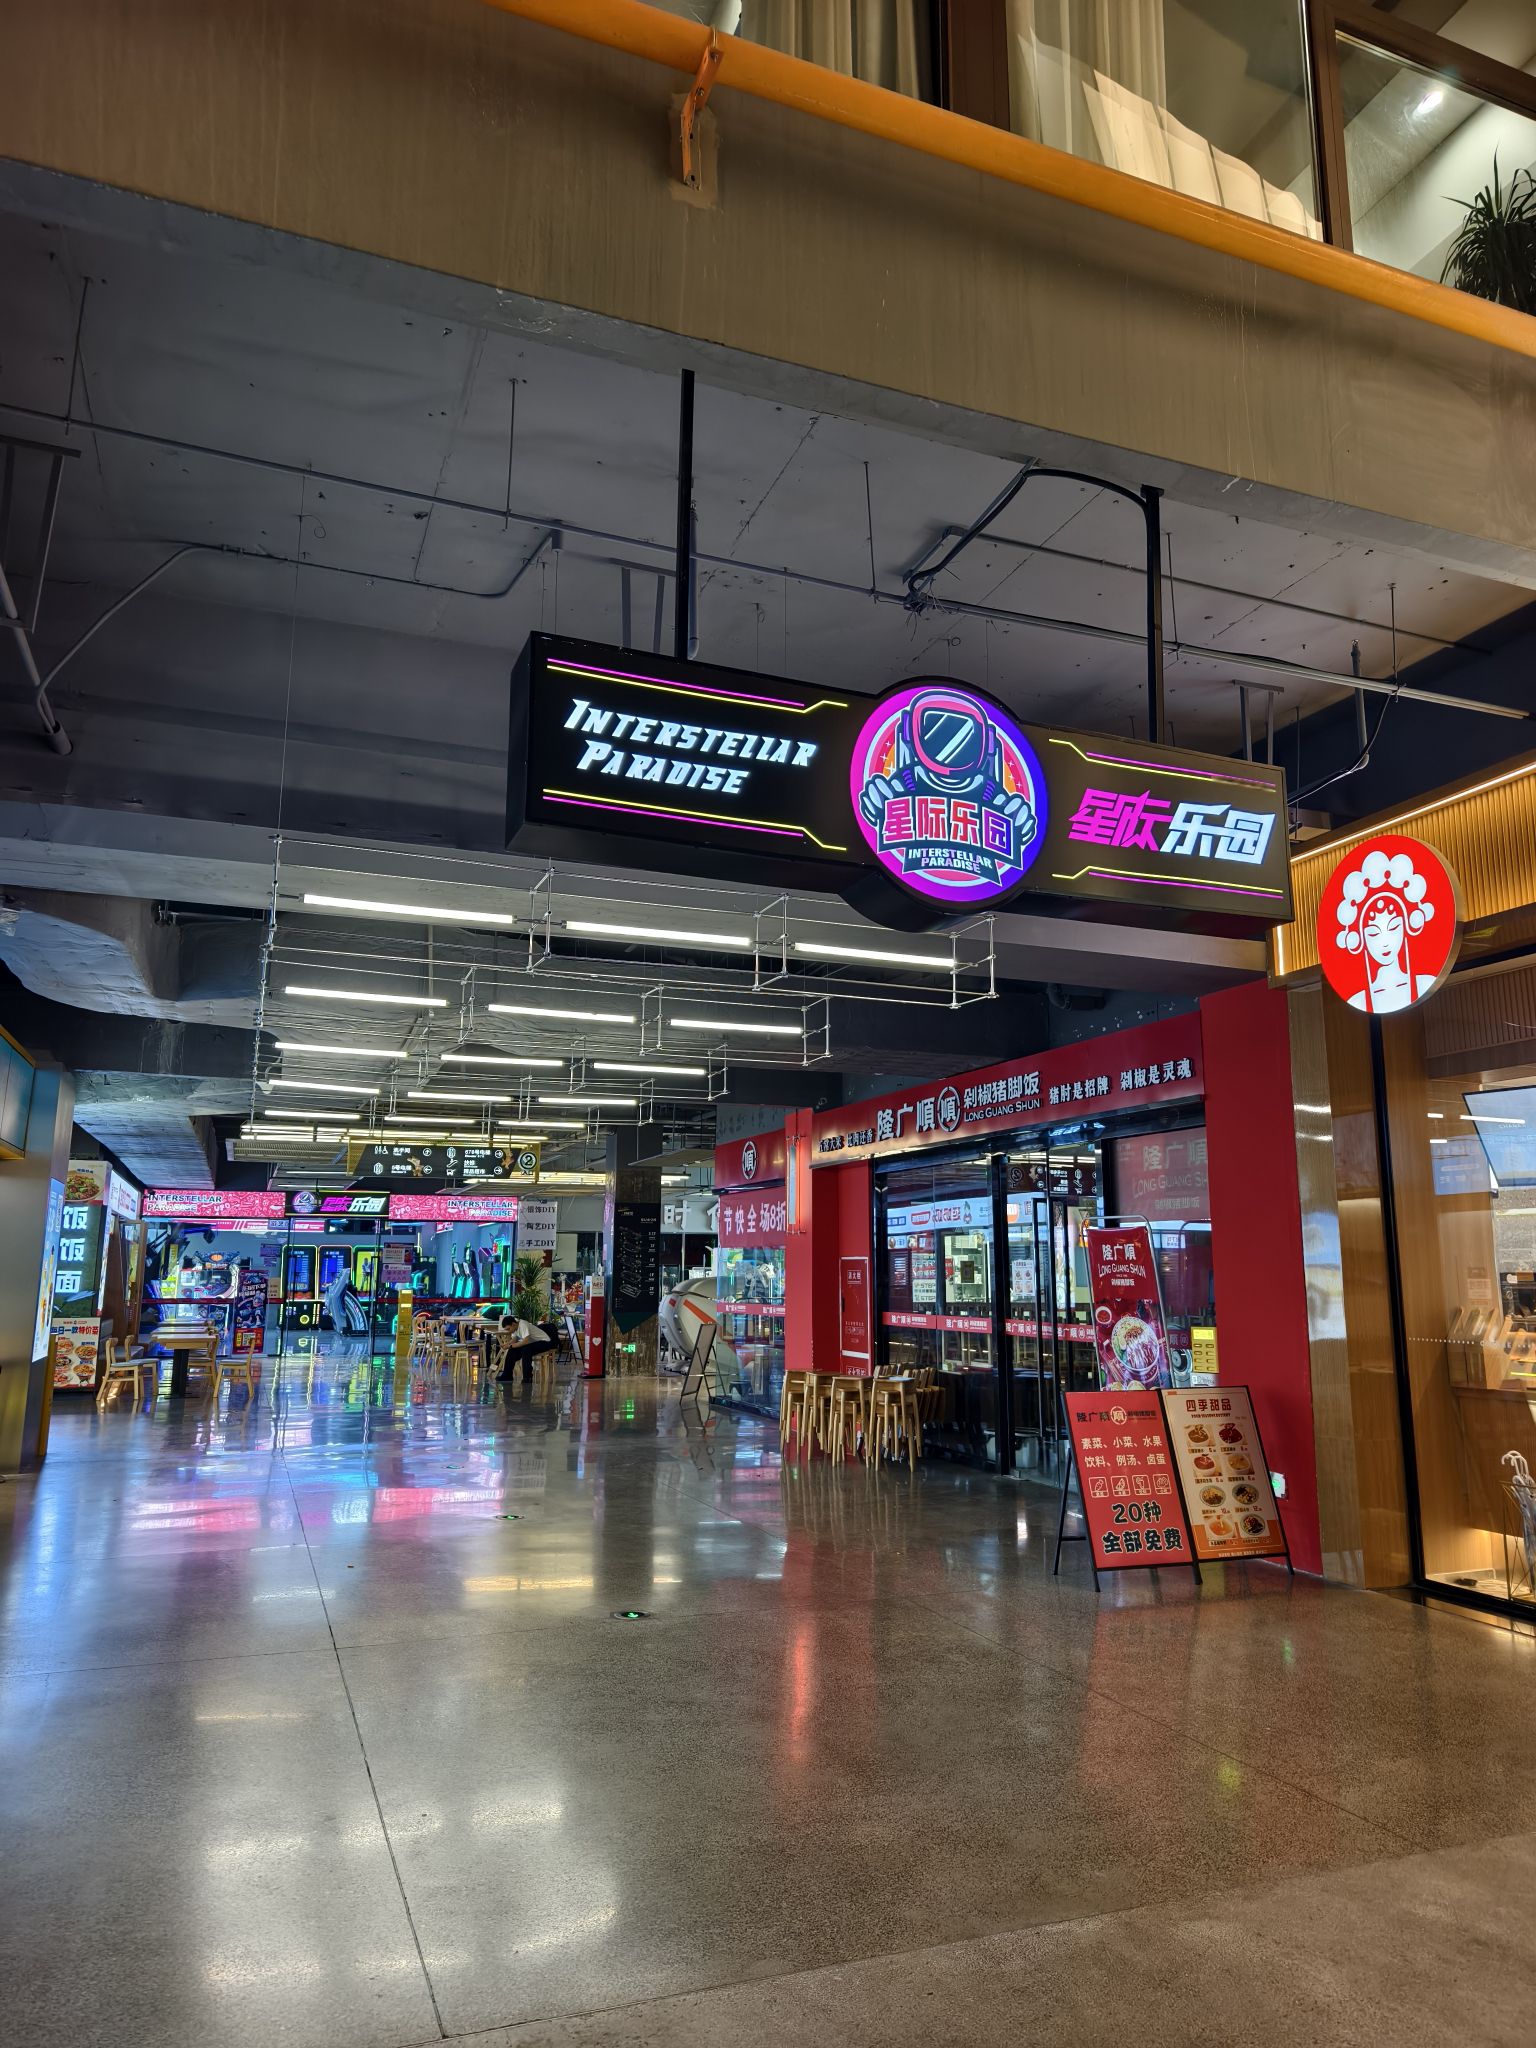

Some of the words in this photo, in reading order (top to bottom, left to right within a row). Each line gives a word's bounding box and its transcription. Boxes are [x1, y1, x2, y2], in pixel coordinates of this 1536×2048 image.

[564, 699, 819, 767] INTERSTELLAR
[576, 740, 750, 795] PARADISE
[882, 796, 1013, 859] 星际乐园
[1069, 789, 1276, 864] 星际乐园
[908, 848, 993, 868] INTERSTELLAR
[921, 857, 981, 873] PARADISE
[963, 1071, 1040, 1110] 剁椒猪脚饭
[1049, 1075, 1109, 1105] 猪肘是招牌
[1120, 1057, 1192, 1091] 剁椒是灵魂
[964, 1110, 984, 1122] LONG
[985, 1105, 1014, 1119] GUANG
[1015, 1099, 1040, 1112] SHUN
[147, 1203, 198, 1212] PARADISE
[148, 1194, 222, 1203] INTERSTELLAR
[447, 1199, 513, 1208] INTERSTELLAR
[468, 1209, 513, 1217] PARADISE
[526, 1222, 556, 1230] 陶艺DIY
[526, 1239, 555, 1247] 手工DIY
[1098, 1263, 1112, 1278] LONG
[1112, 1263, 1129, 1273] GUANG
[1130, 1263, 1147, 1279] SHUN
[1186, 1398, 1232, 1412] 四季甜品
[1111, 1500, 1162, 1525] 20种
[1102, 1526, 1183, 1555] 全部免费
